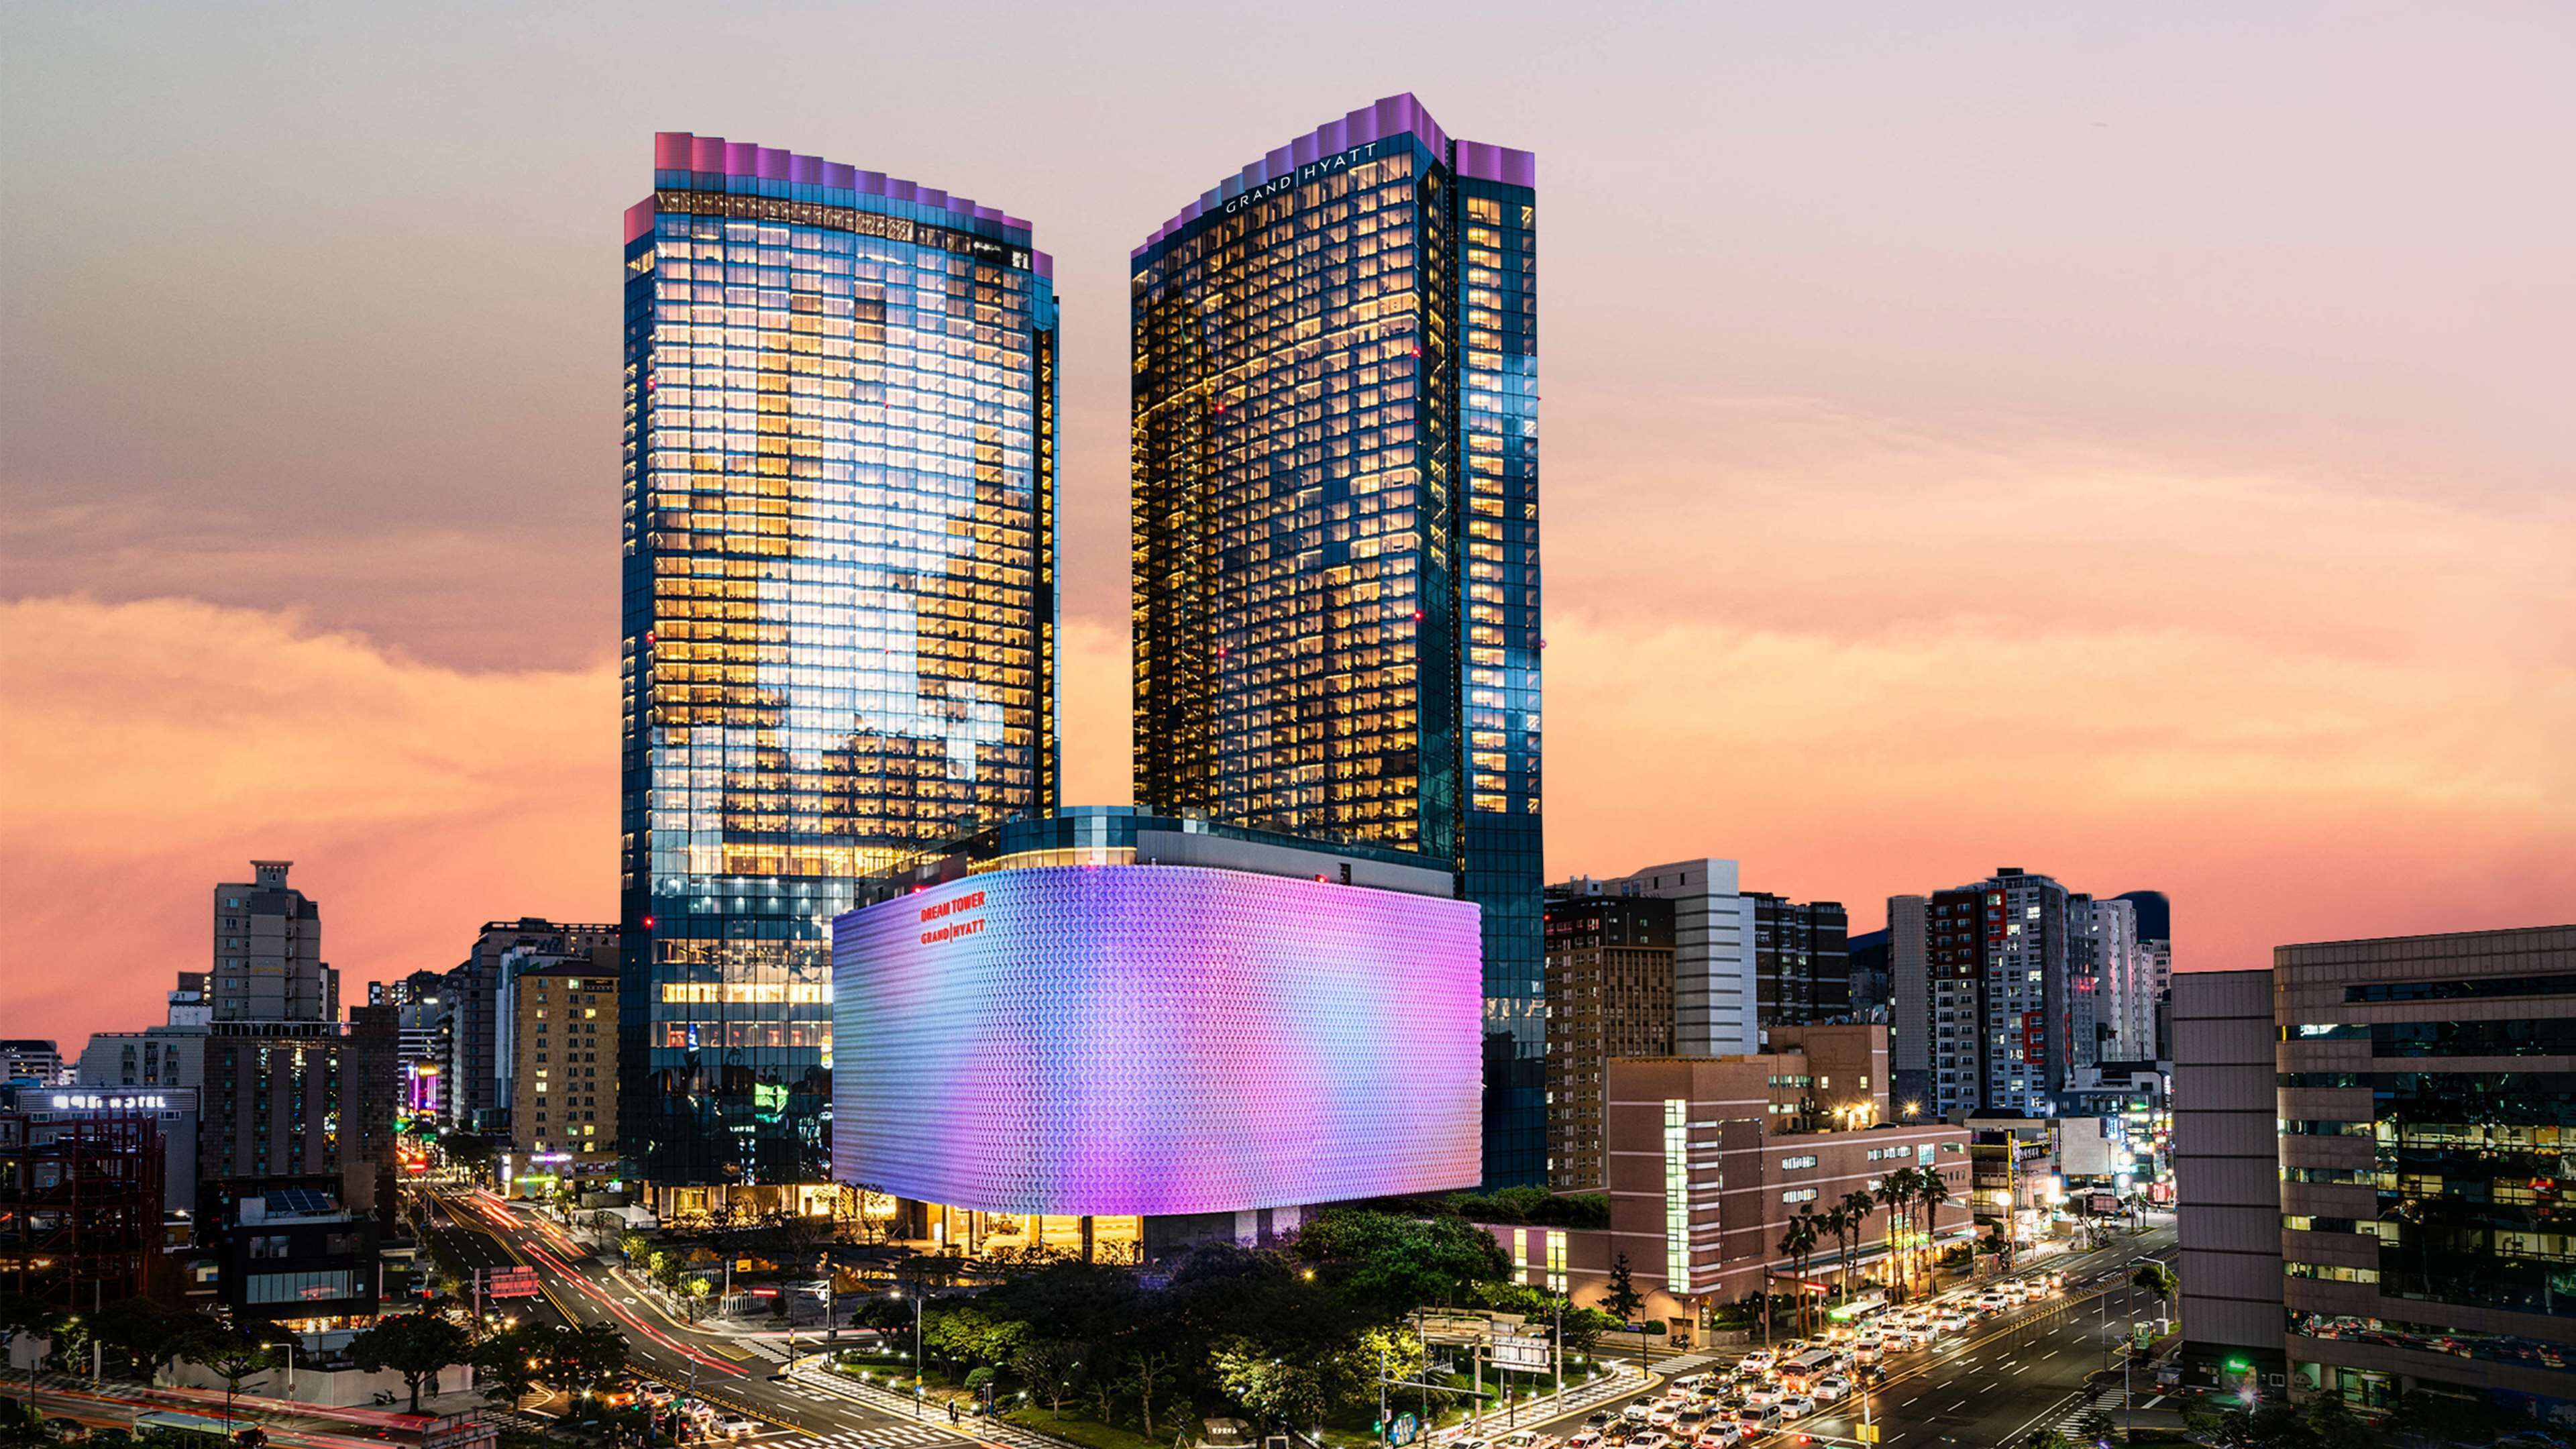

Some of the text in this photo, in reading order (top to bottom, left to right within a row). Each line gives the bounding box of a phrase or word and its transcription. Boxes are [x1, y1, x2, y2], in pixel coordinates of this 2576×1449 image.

[1226, 143, 1376, 213] GRAND HYATT
[920, 891, 985, 922] DREAM TOWER
[920, 918, 985, 945] GRAND HYATT
